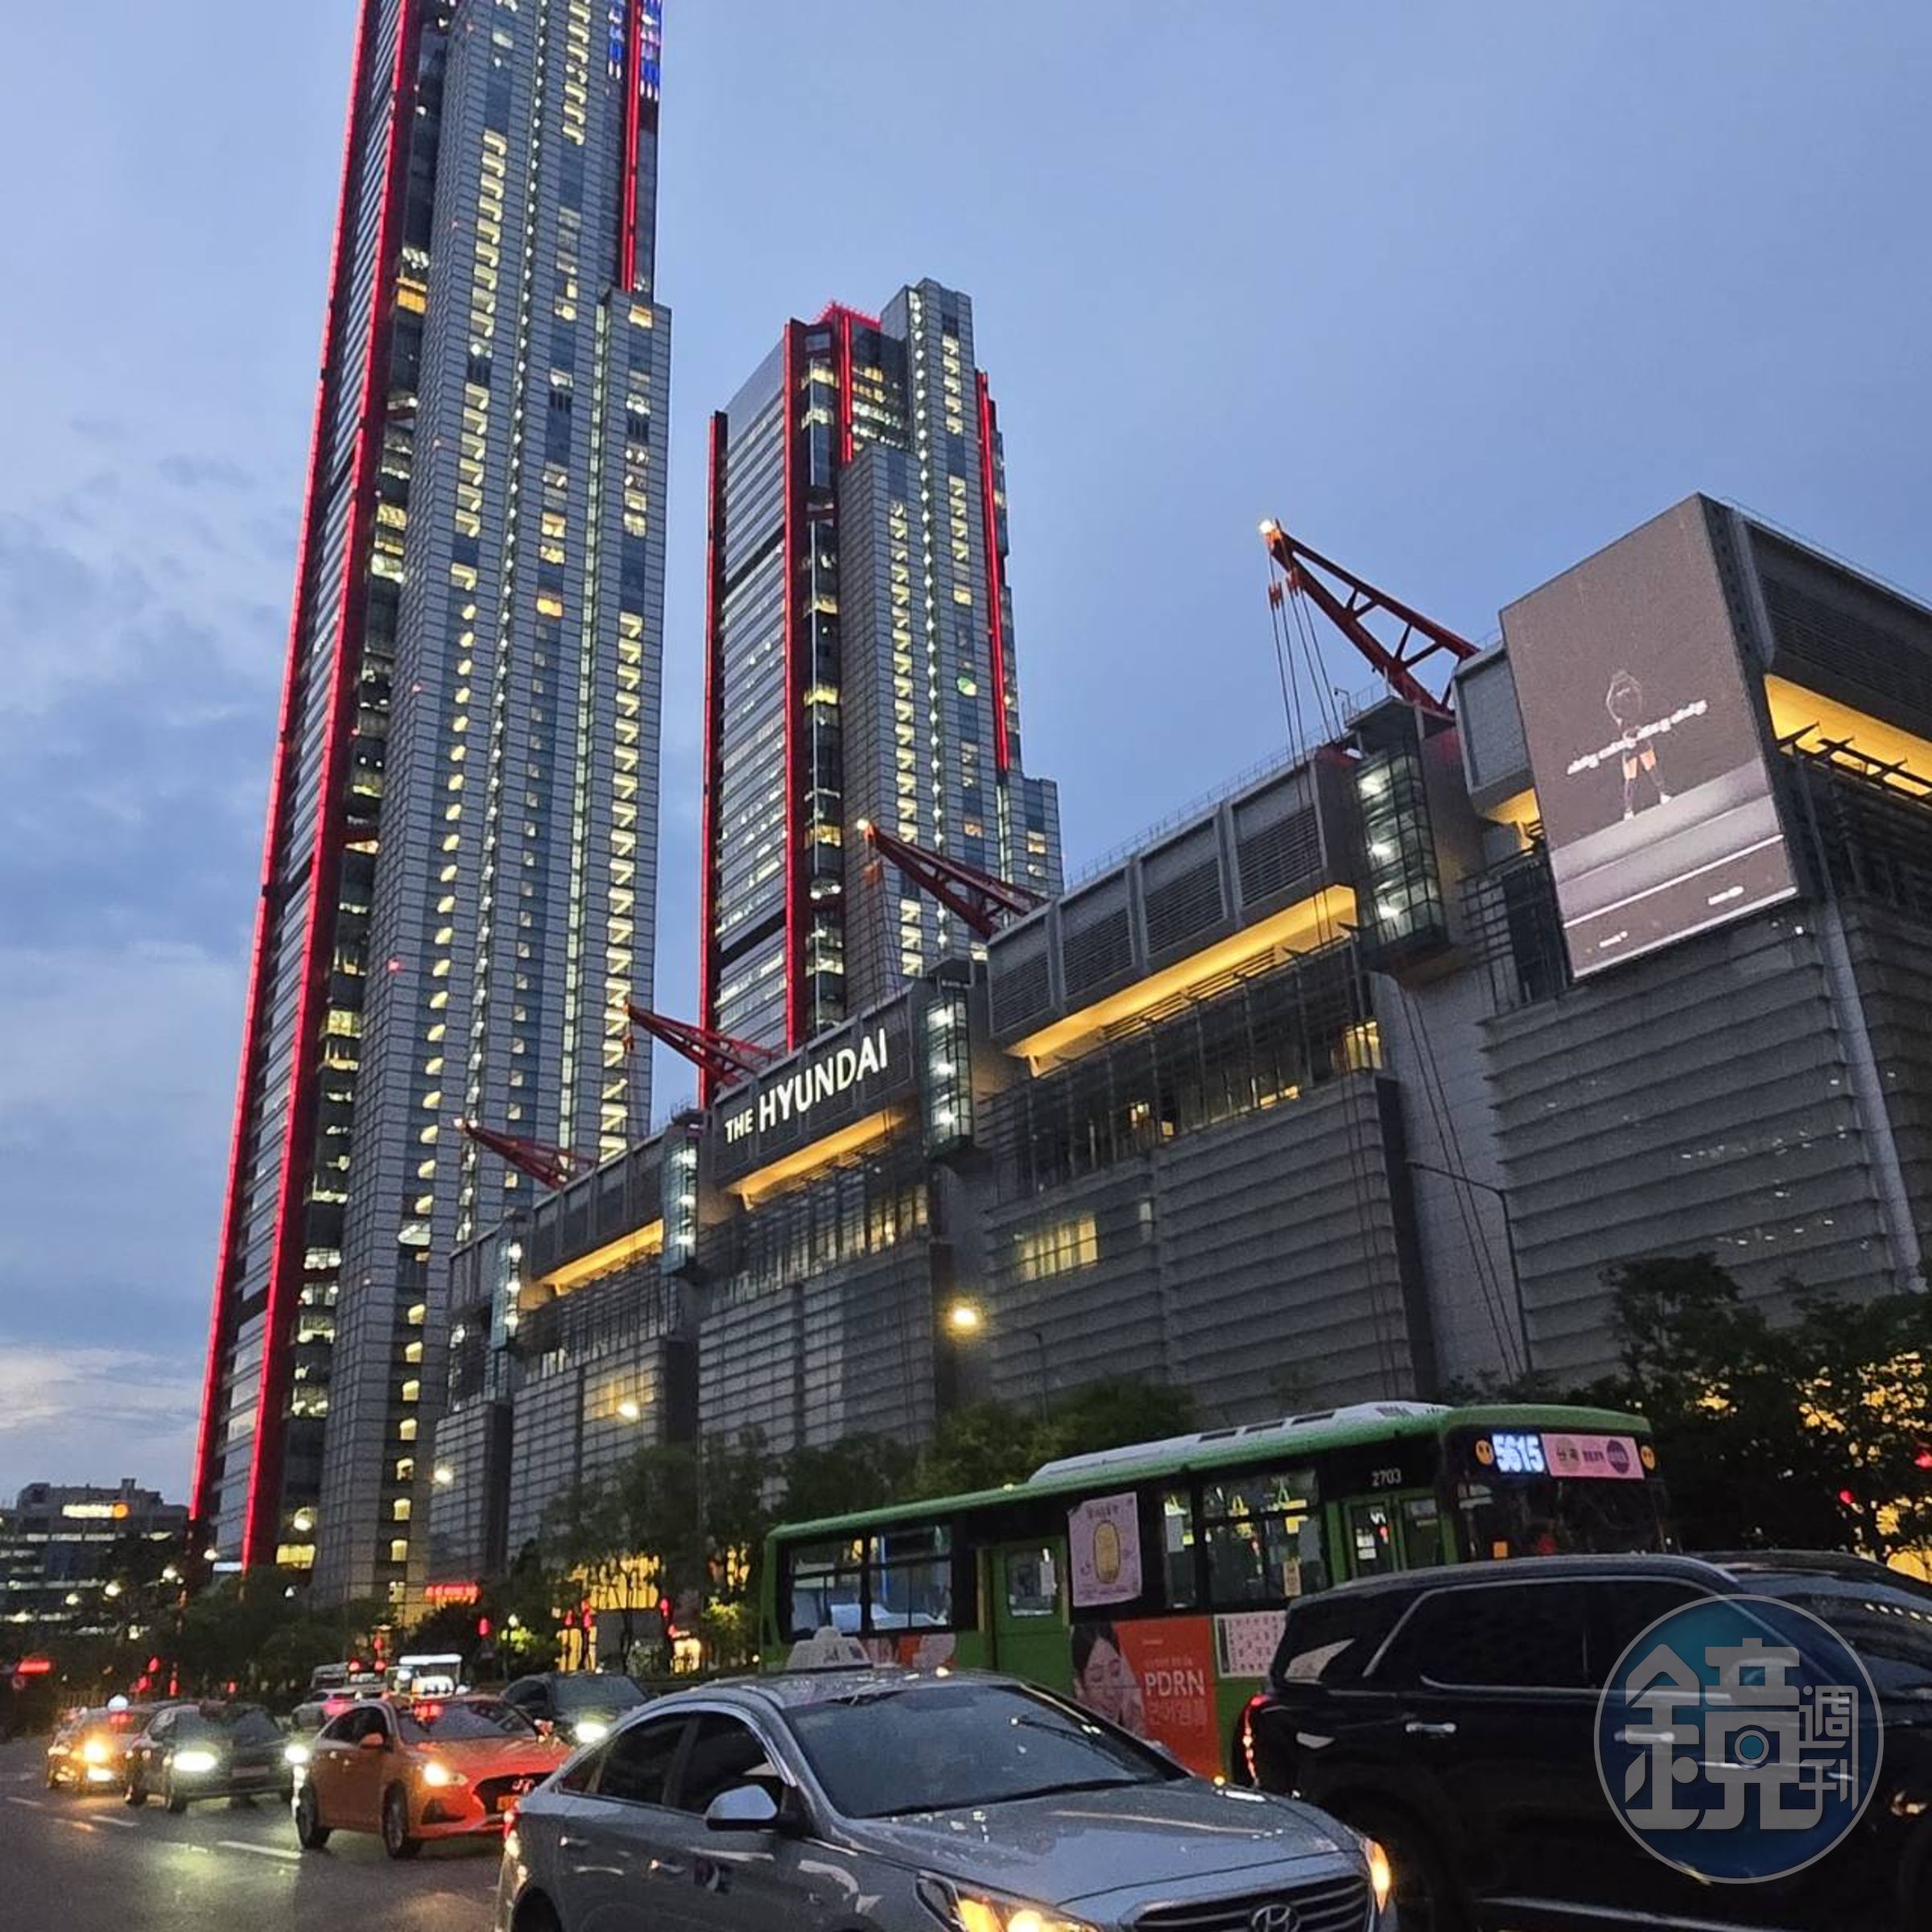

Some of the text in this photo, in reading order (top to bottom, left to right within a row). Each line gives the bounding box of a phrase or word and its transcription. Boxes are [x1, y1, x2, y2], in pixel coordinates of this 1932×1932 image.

[725, 1028, 887, 1143] THE HYUNDAI
[1371, 1468, 1402, 1487] 2703
[1144, 1669, 1206, 1697] PDRN
